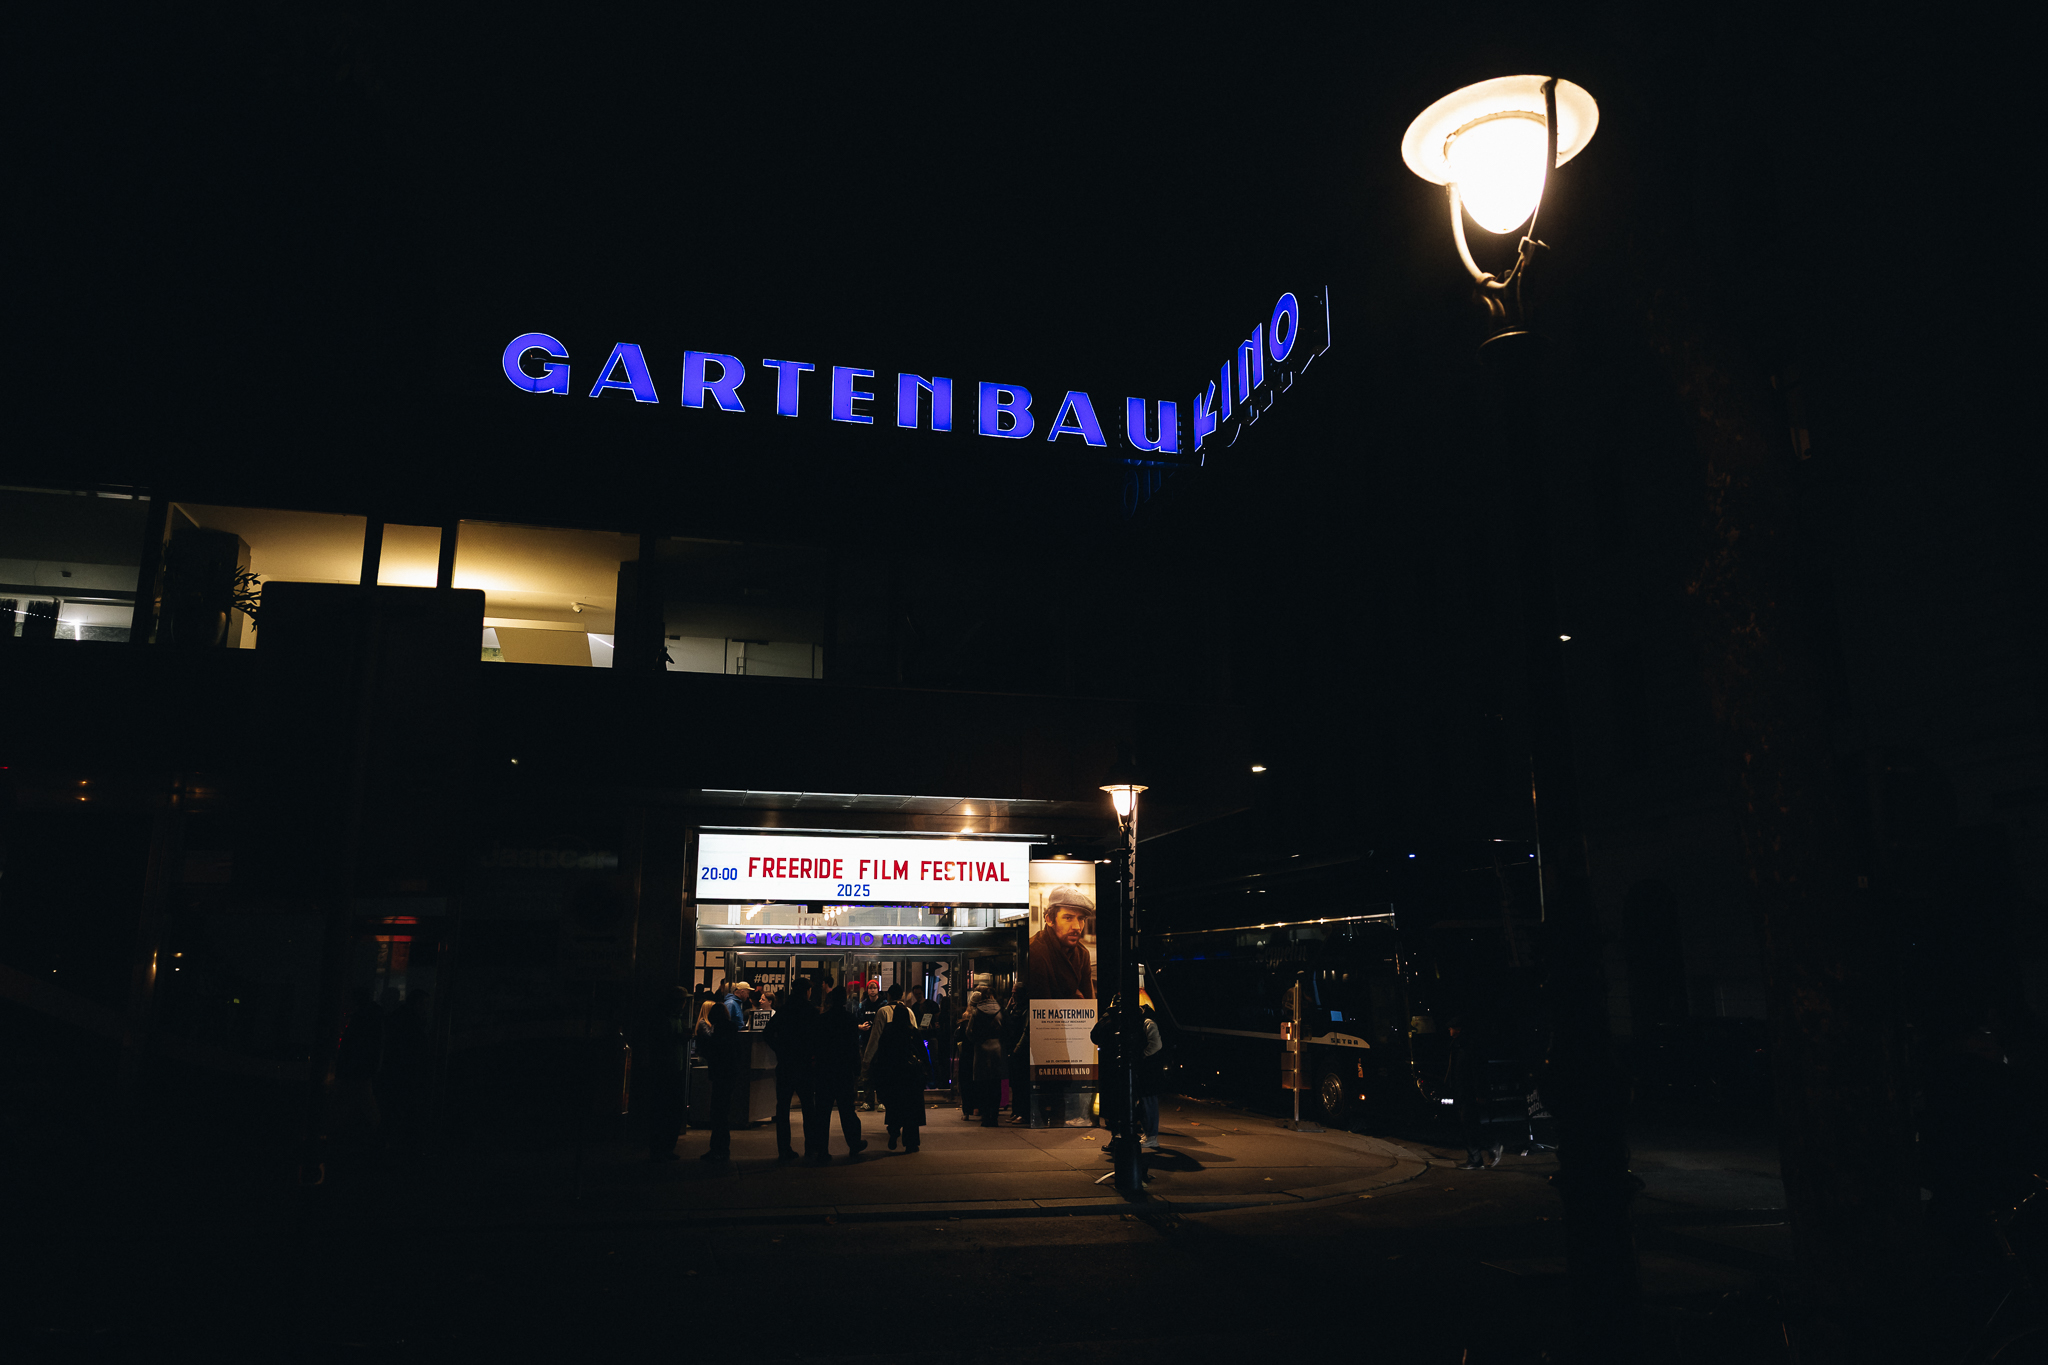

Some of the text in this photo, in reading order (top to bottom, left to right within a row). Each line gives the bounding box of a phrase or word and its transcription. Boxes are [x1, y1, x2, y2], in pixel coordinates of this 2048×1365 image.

[701, 856, 1010, 882] 20:00 FREERIDE FILM FESTIVAL
[836, 883, 871, 897] 2025
[745, 931, 952, 946] EINGANG KINO EINGANG
[1032, 1008, 1095, 1019] THE MASTERMIND
[1330, 1037, 1359, 1046] SETRA
[1038, 1067, 1091, 1076] GARTENBAUKINO
